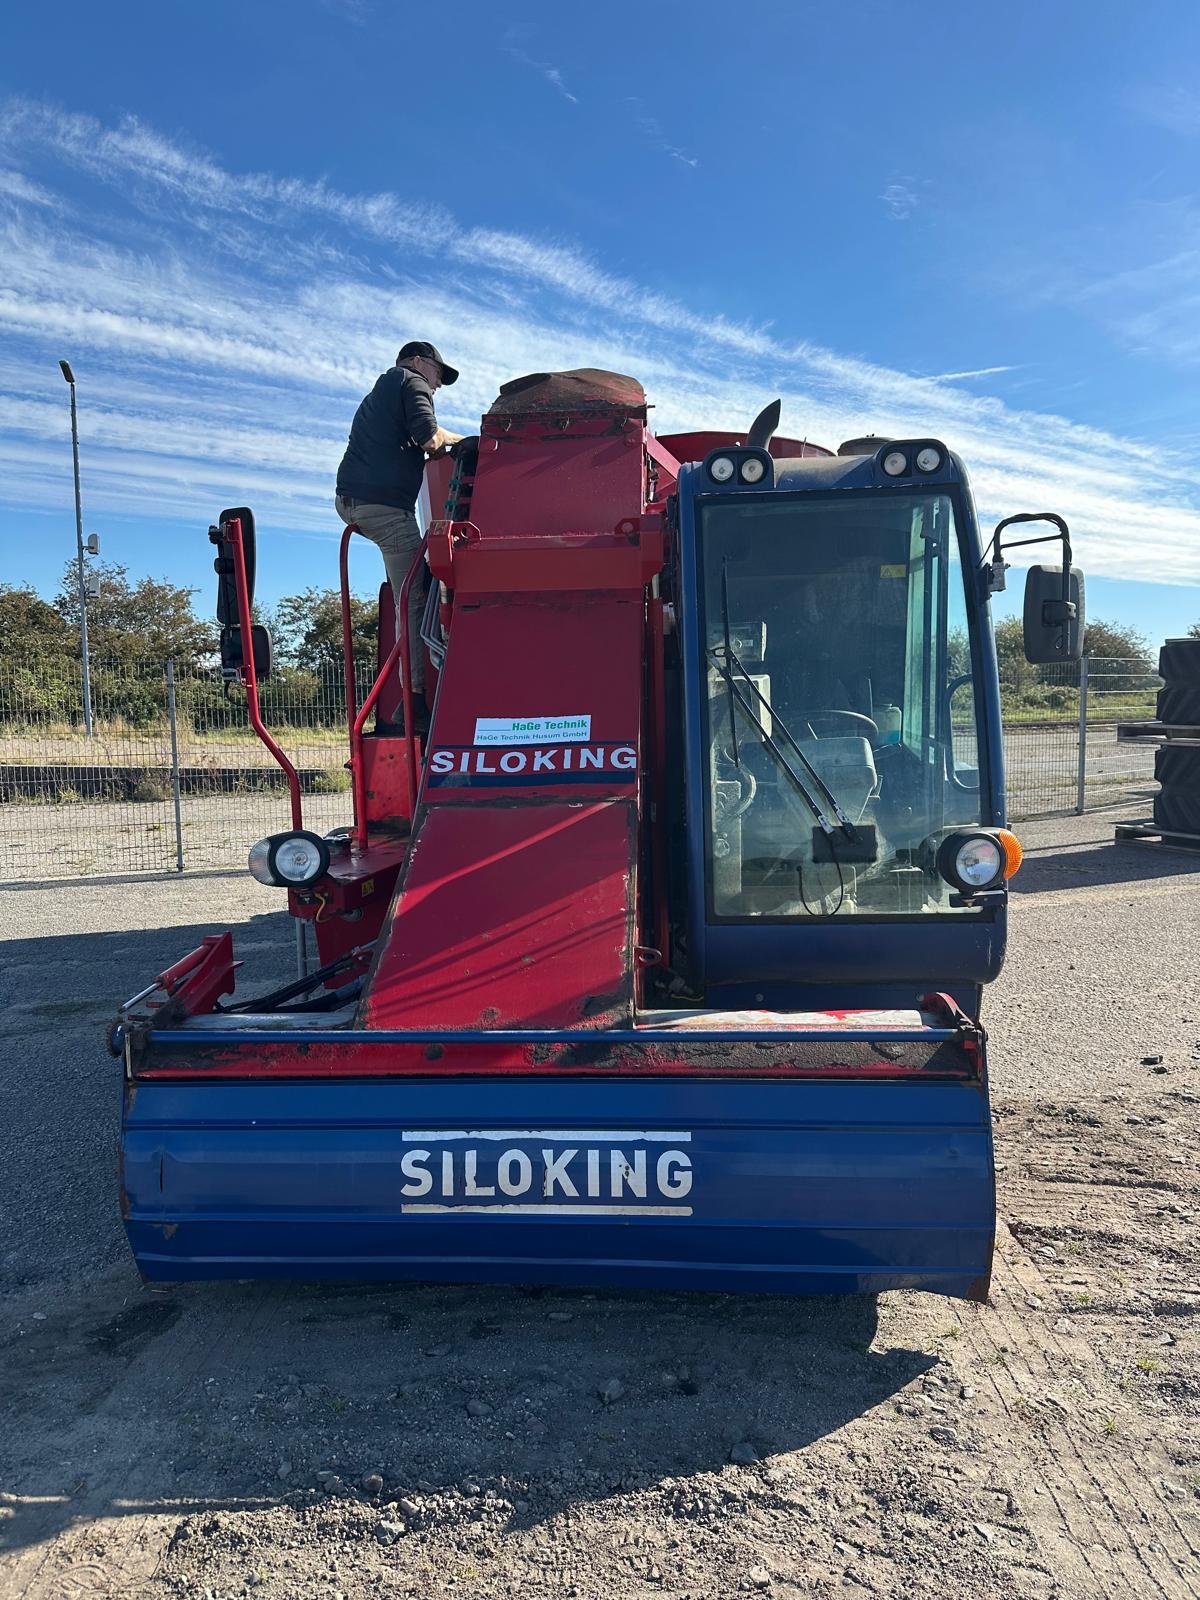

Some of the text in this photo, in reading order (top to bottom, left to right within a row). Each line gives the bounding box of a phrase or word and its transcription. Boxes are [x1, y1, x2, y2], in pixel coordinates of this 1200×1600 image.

[512, 719, 587, 731] HaGe Technik
[500, 733, 530, 741] Technik
[532, 732, 561, 740] Husum
[430, 747, 637, 773] SILOKING
[400, 1149, 693, 1199] SILOKING
